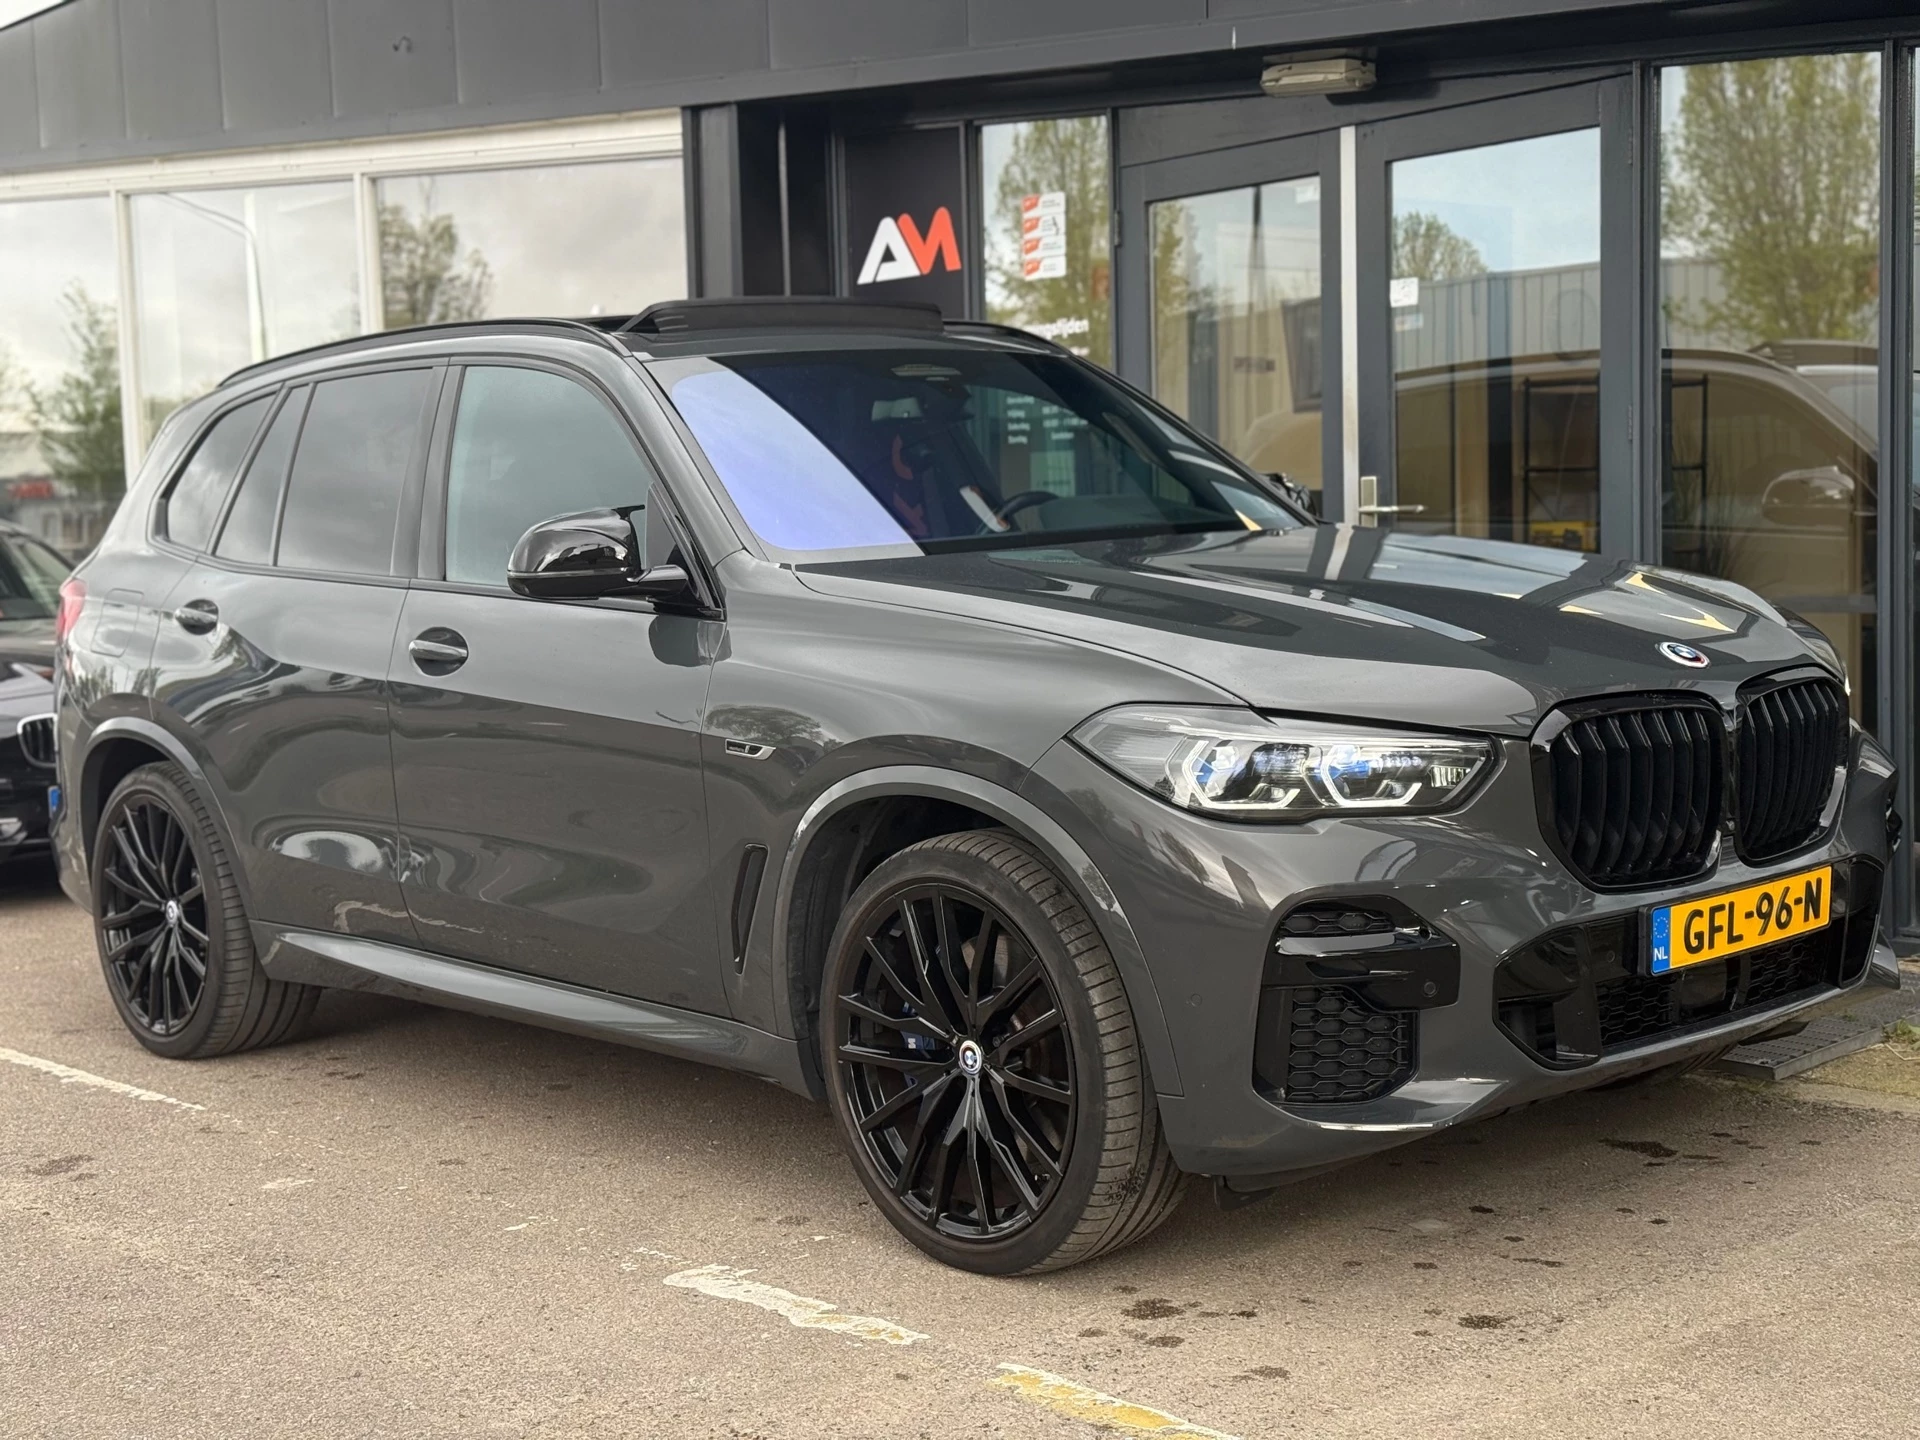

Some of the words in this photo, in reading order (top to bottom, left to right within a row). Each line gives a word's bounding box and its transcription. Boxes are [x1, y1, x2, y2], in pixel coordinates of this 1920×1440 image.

[857, 207, 962, 285] AM
[1653, 946, 1668, 962] NL
[1683, 877, 1822, 955] GFL-96-N
